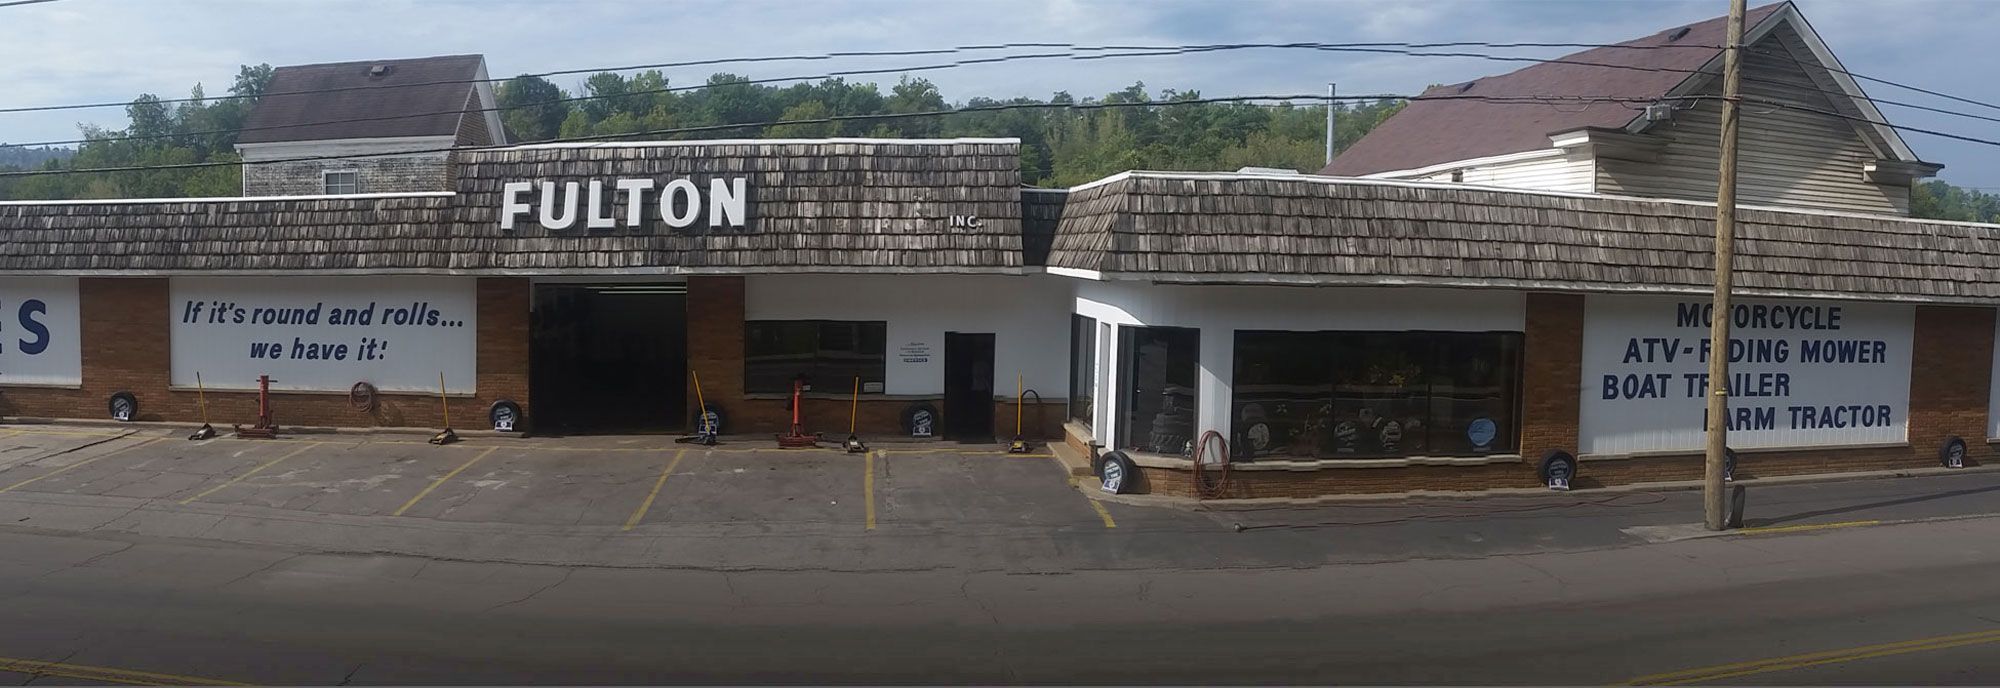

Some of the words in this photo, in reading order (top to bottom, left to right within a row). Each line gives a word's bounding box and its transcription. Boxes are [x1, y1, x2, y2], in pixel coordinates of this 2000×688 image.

[500, 177, 747, 230] FULTON
[949, 214, 982, 228] INC.
[0, 298, 51, 355] S
[182, 300, 204, 324] If
[208, 300, 246, 324] it's
[251, 301, 323, 325] round
[328, 301, 375, 326] and
[381, 301, 464, 328] rolls...
[1676, 302, 1842, 331] MOORCYCLE
[250, 342, 283, 360] we
[290, 336, 348, 361] have
[357, 337, 389, 361] it!
[1800, 339, 1887, 365] MOWER
[1602, 373, 1672, 400] BOAT
[1788, 403, 1892, 431] TRACTOR
